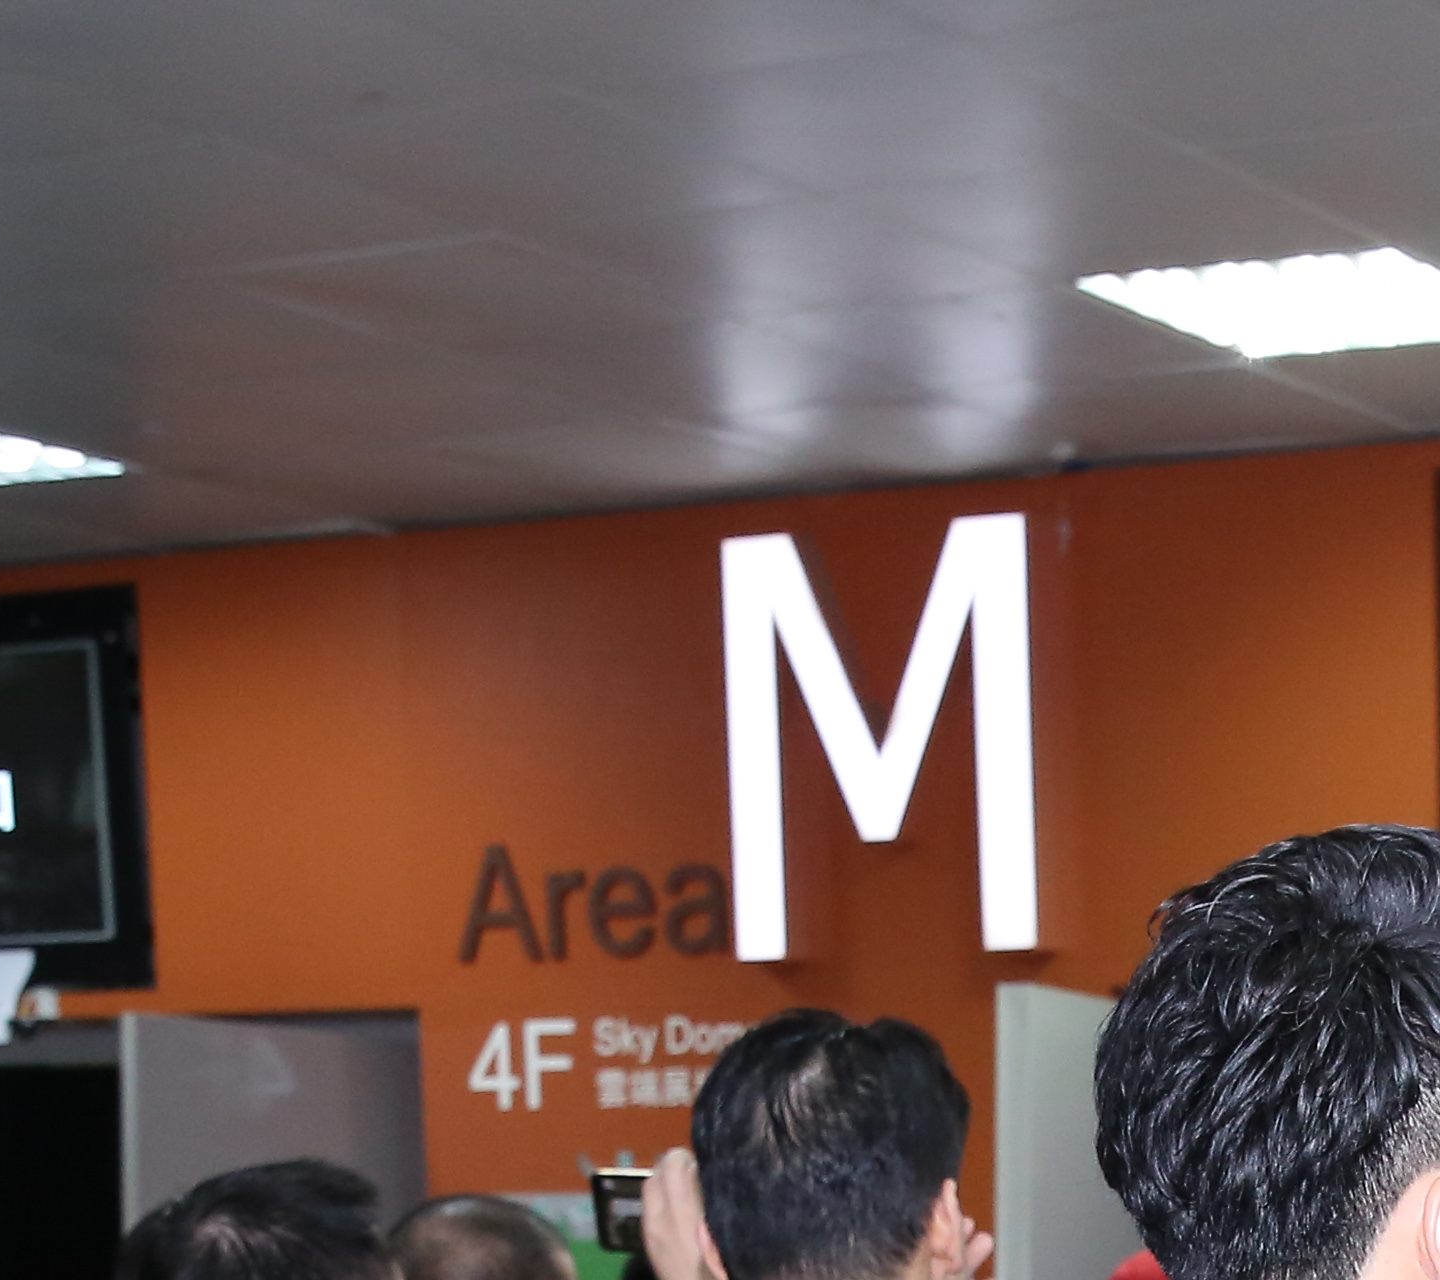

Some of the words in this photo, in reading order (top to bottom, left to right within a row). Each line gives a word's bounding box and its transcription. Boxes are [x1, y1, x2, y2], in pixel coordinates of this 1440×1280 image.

[458, 843, 729, 966] Area
[720, 511, 1039, 963] M
[469, 1016, 576, 1113] 4F
[592, 1014, 660, 1065] Sky
[663, 1013, 756, 1056] Dom
